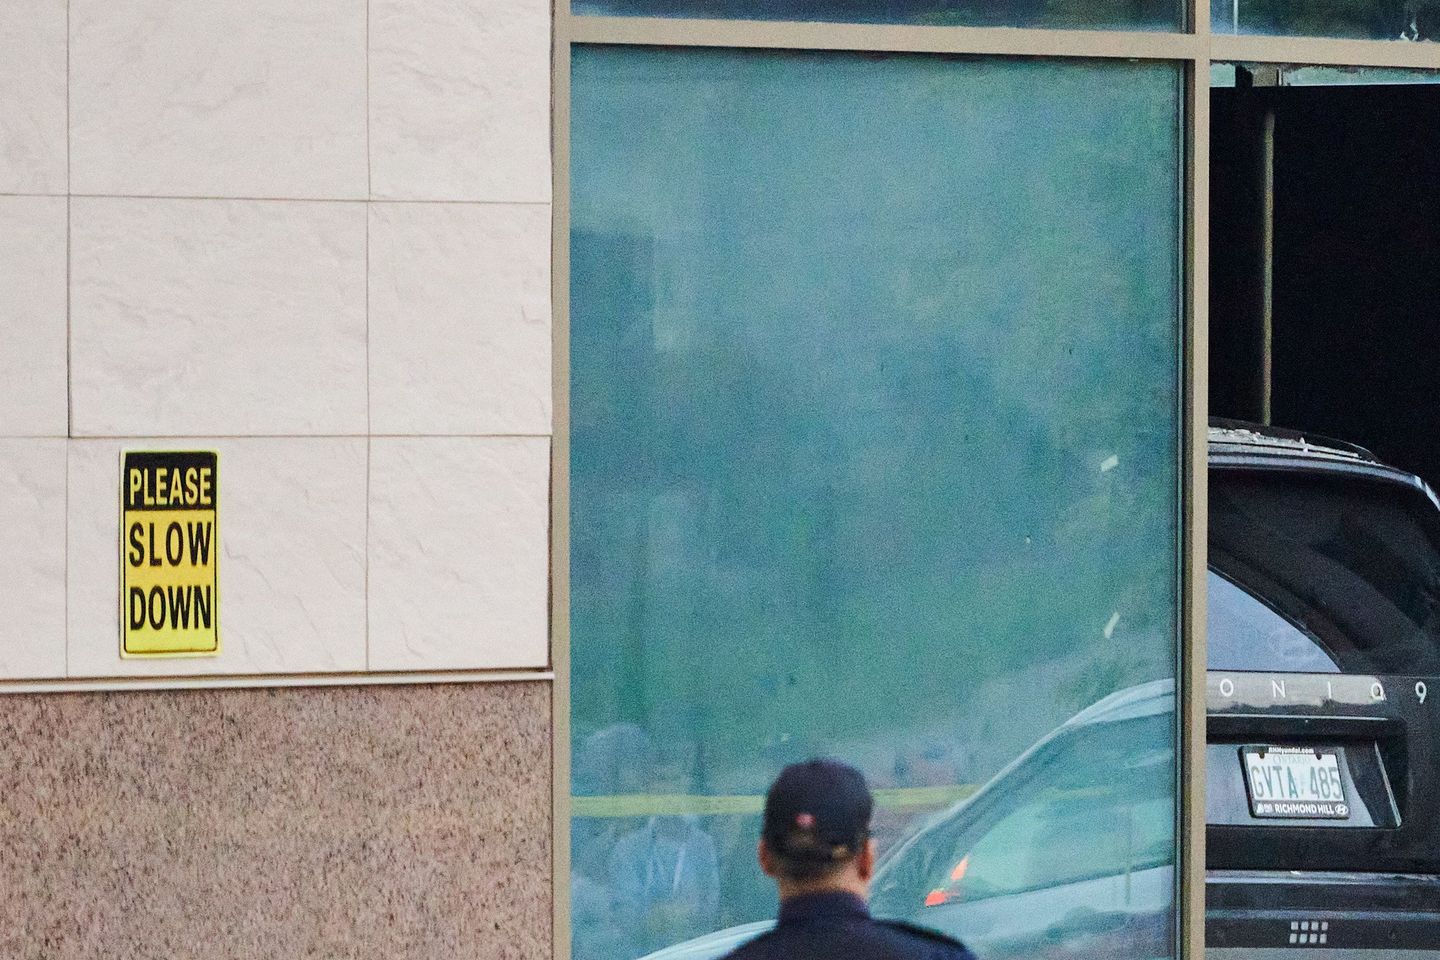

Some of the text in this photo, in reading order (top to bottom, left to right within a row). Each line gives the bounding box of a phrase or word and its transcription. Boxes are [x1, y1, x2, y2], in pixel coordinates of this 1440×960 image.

[129, 468, 212, 505] PLEASE
[129, 521, 212, 567] SLOW
[130, 585, 212, 630] DOWN
[1414, 681, 1428, 704] 9
[1251, 766, 1341, 800] GVTA 485
[1274, 803, 1318, 815] RICHMOND
[1317, 804, 1335, 815] HILL
